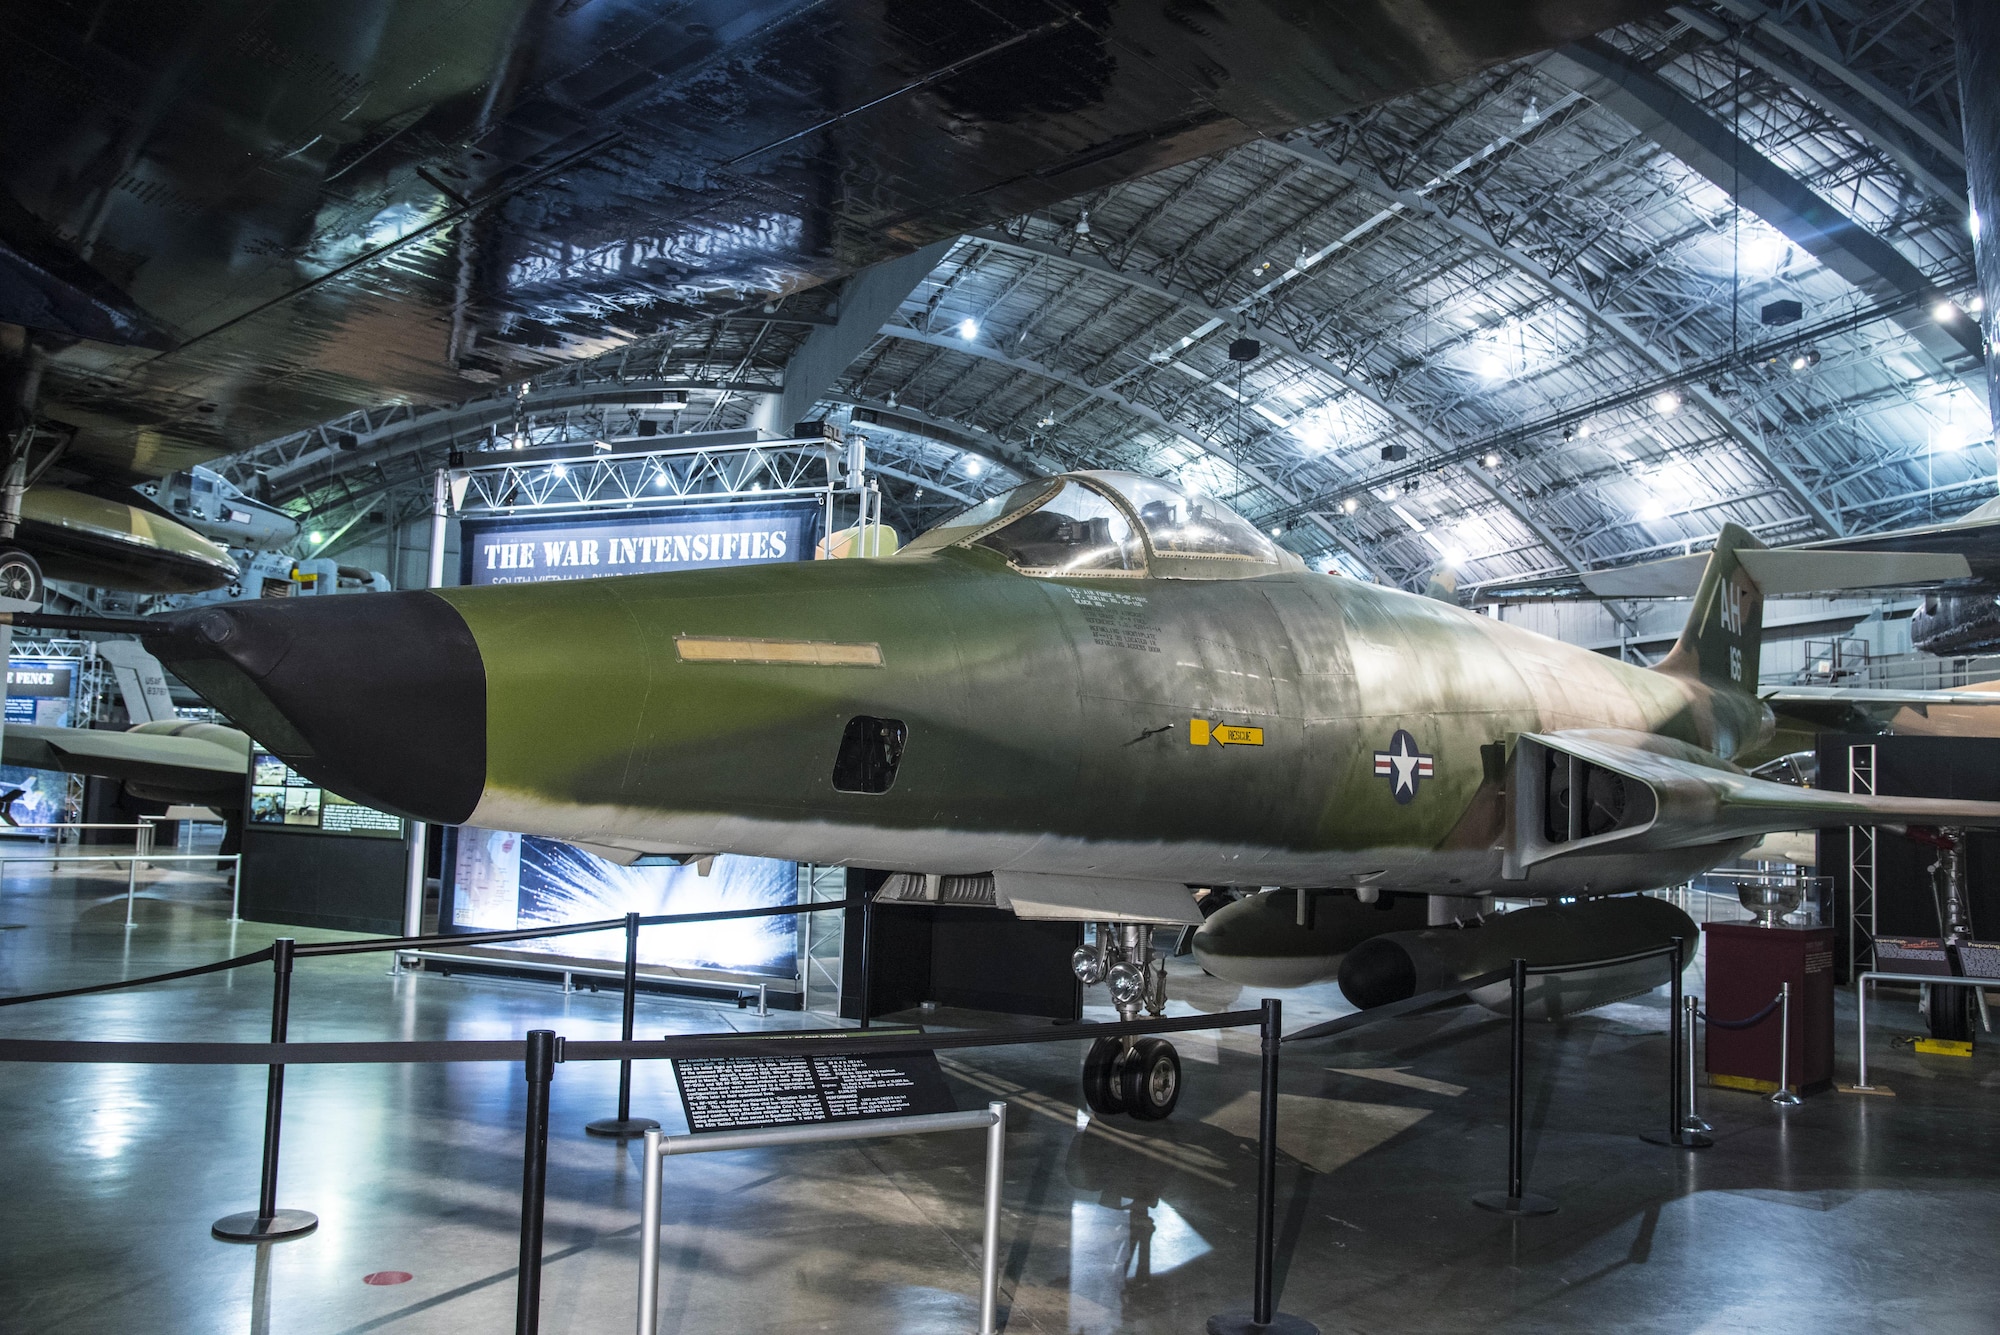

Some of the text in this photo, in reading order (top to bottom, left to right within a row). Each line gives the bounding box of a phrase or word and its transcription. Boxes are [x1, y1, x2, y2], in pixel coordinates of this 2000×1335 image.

[484, 530, 787, 570] THE WAR INTENSIFIES
[1721, 577, 1742, 637] AH
[1730, 645, 1742, 683] 166
[16, 671, 54, 685] FENCE
[1228, 730, 1251, 741] RESCUE
[1968, 941, 2000, 950] Preparing
